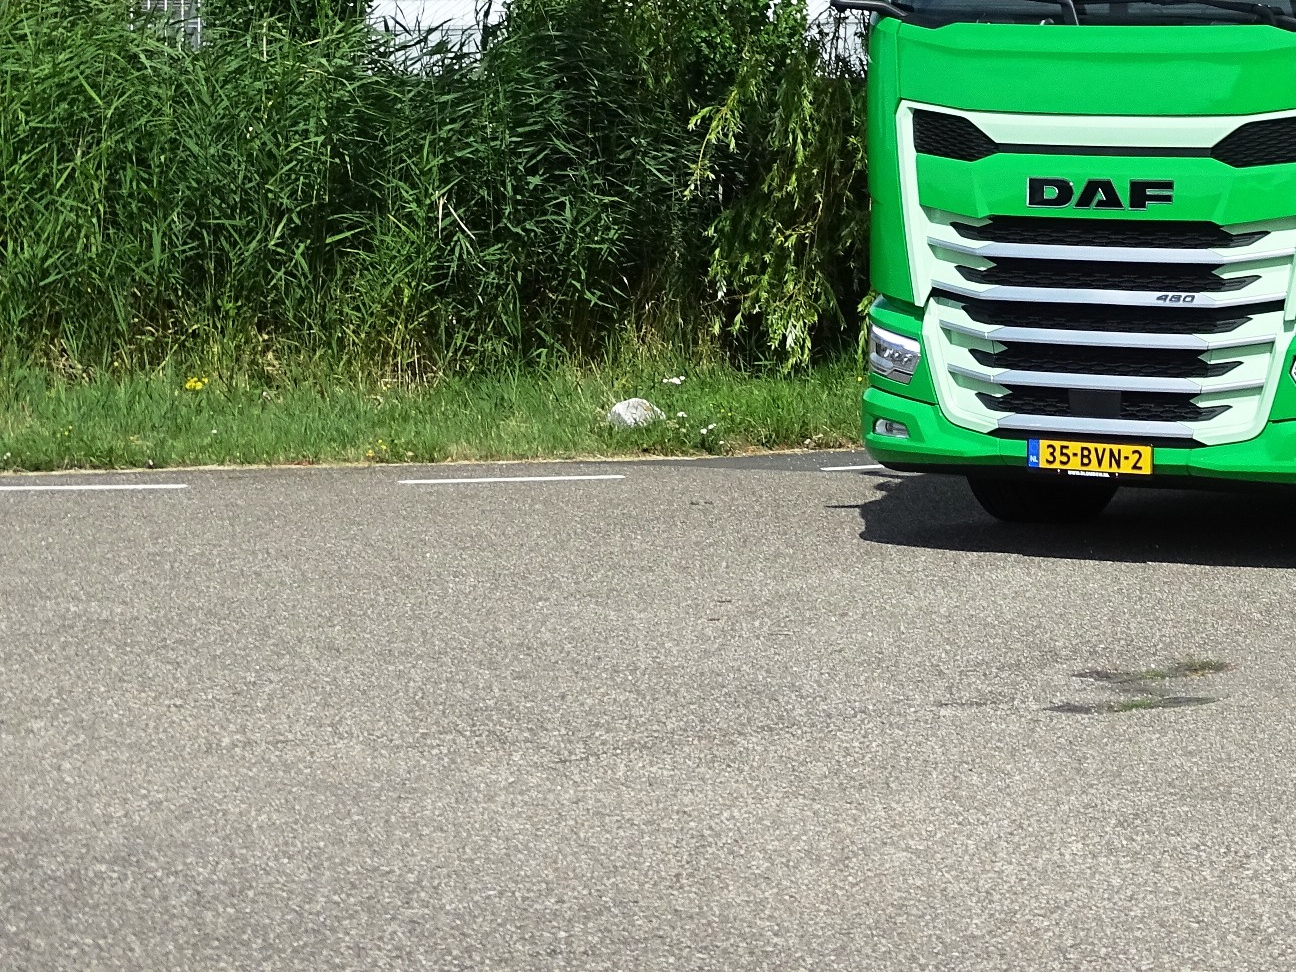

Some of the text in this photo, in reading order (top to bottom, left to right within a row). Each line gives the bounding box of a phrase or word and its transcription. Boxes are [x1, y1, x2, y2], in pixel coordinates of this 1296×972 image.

[1026, 177, 1175, 211] DAF
[1029, 455, 1039, 463] NL
[1045, 444, 1143, 471] 35-BVN-2
